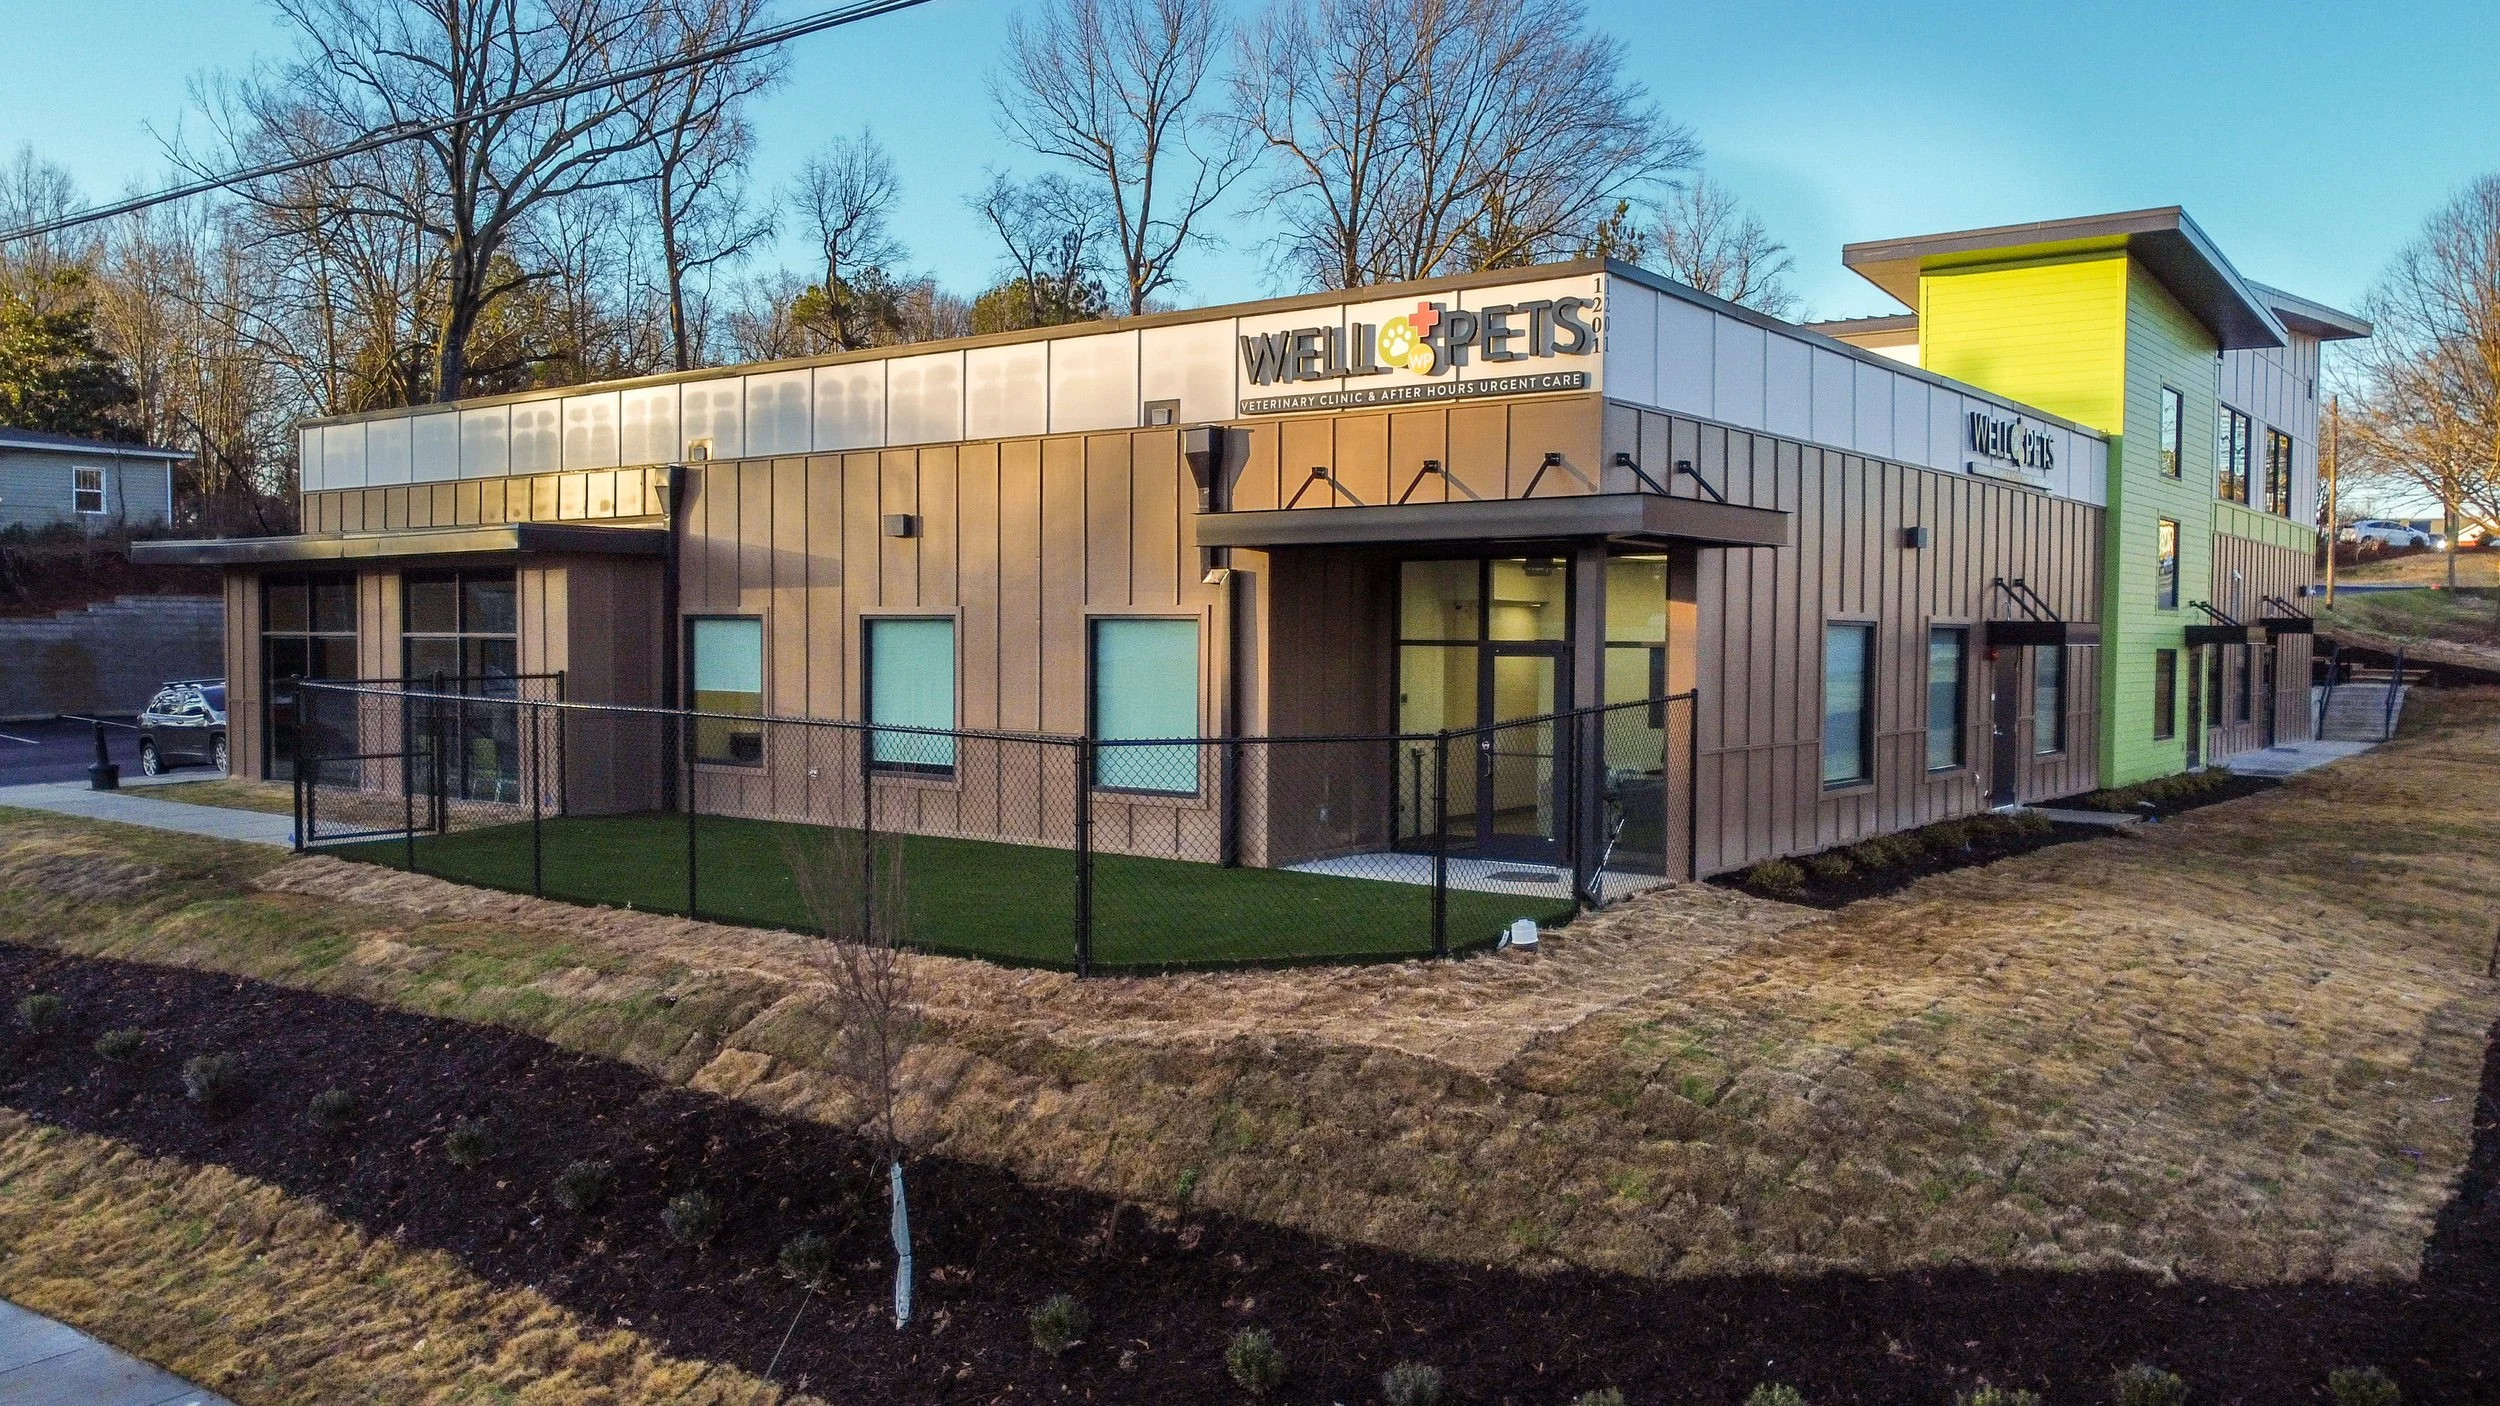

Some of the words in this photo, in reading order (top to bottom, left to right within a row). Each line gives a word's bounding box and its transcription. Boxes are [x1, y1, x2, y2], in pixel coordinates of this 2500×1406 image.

[1591, 277, 1603, 354] 1201
[1240, 322, 1379, 385] WELL
[1444, 296, 1586, 367] PETS
[1409, 353, 1432, 370] WP
[1241, 396, 1315, 411] VETERINARY
[1319, 392, 1363, 406] CLINIC
[1368, 391, 1376, 402] &
[1381, 387, 1421, 401] AFTER
[1427, 382, 1474, 397] HOURS
[1480, 377, 1537, 393] URGENT
[1542, 373, 1581, 388] CARE
[1970, 411, 2012, 460] WELL
